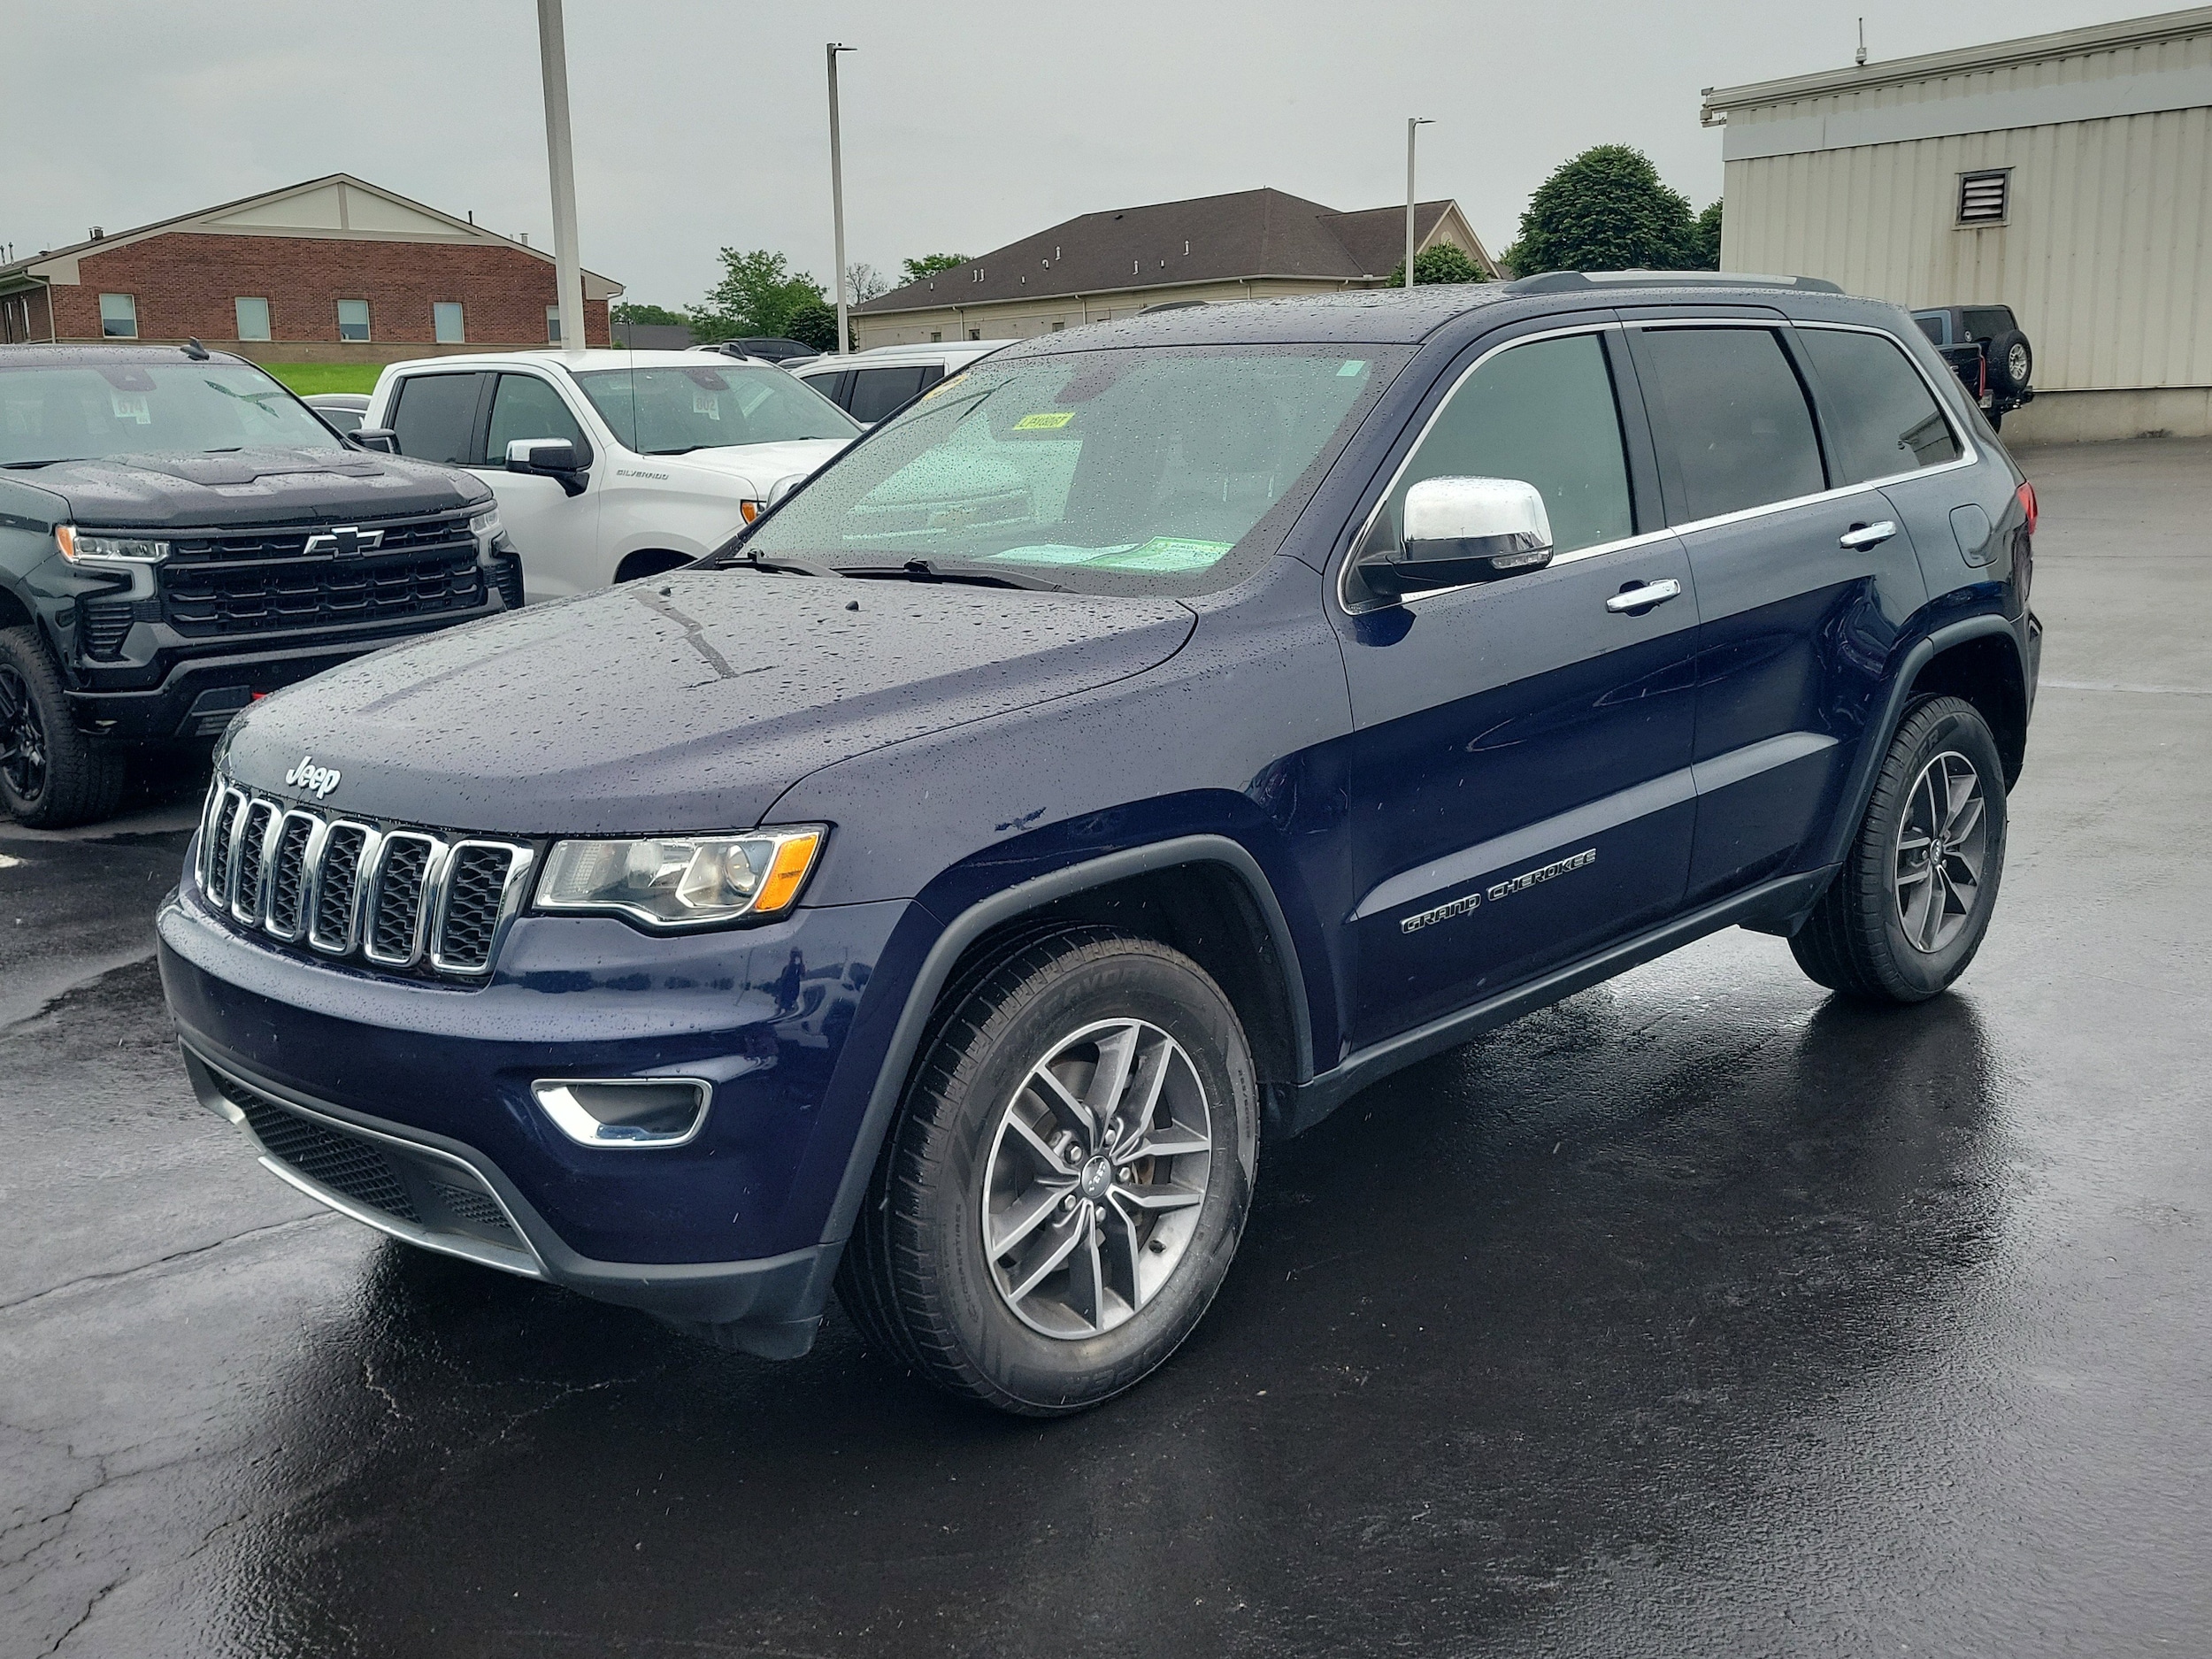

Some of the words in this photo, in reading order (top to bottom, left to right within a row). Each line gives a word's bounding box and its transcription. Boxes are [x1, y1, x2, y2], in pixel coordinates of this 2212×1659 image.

[617, 469, 669, 480] SILVERADO
[285, 755, 342, 800] Jeep
[1401, 893, 1481, 934] GRAND
[1487, 848, 1597, 902] CHEROKEE
